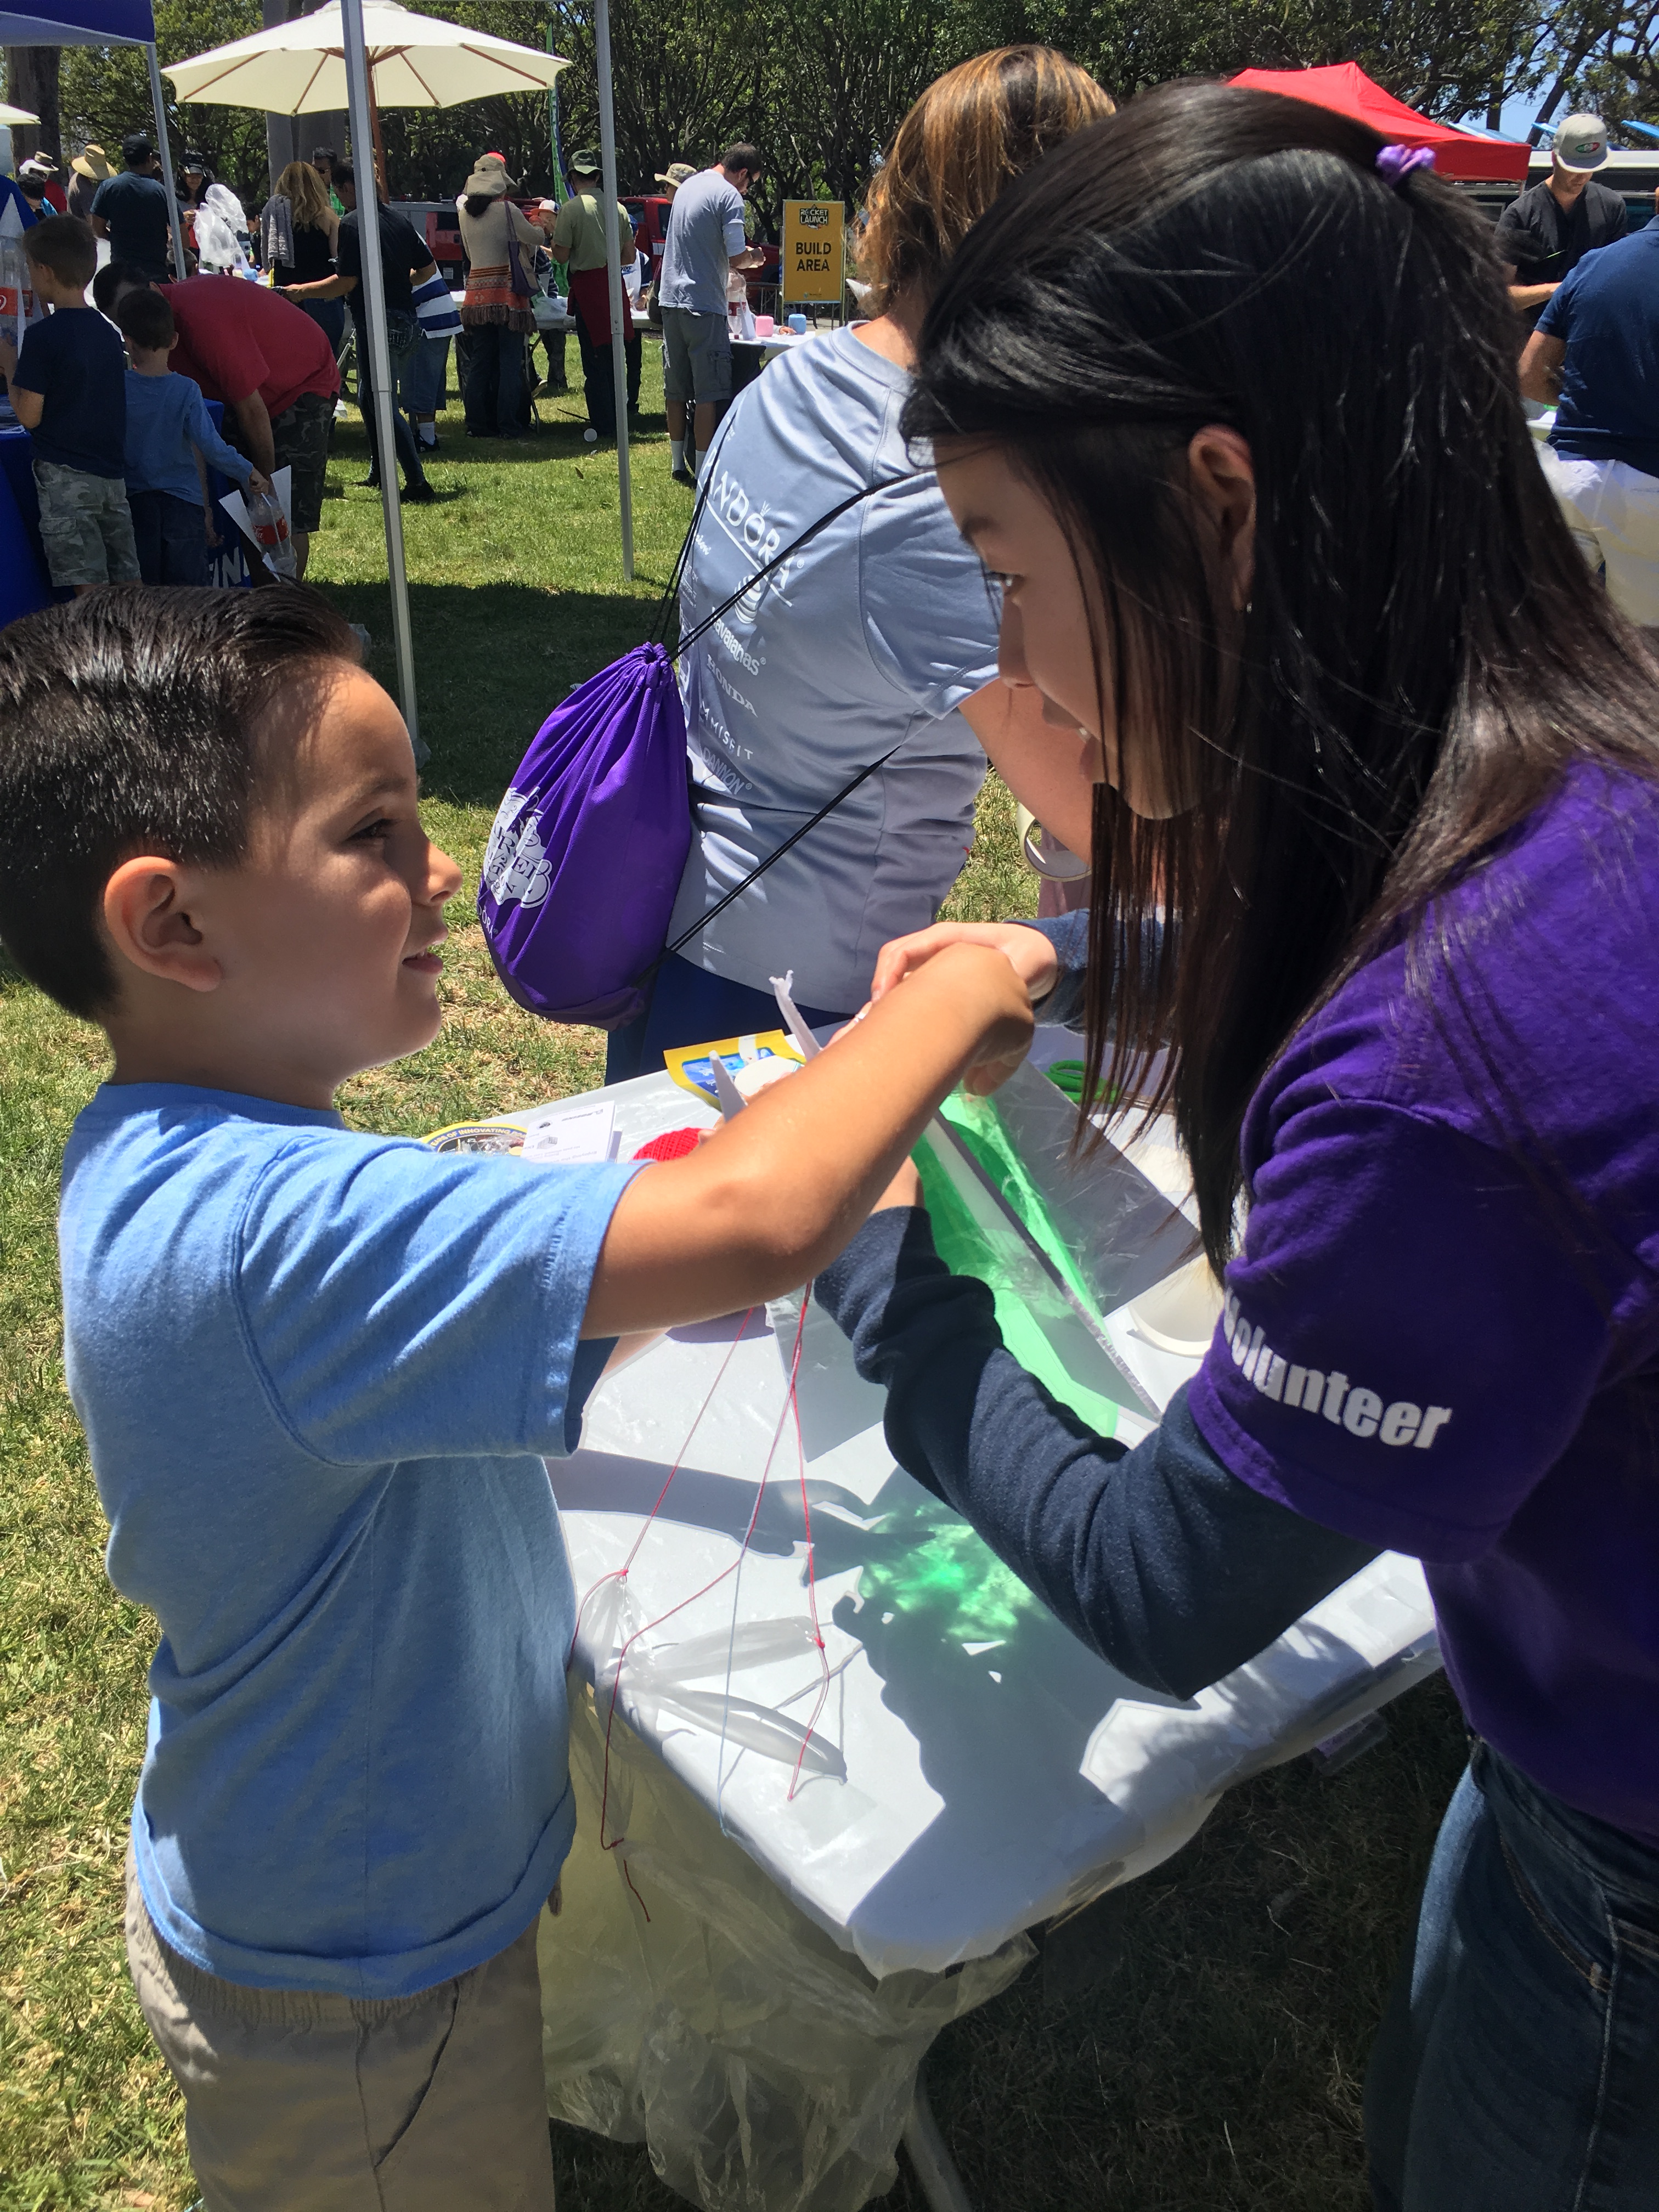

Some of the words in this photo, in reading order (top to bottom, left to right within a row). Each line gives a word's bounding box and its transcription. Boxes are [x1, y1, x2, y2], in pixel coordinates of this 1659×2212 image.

[800, 216, 828, 224] LAUNCH
[795, 242, 831, 255] BUILD
[797, 259, 830, 272] AREA
[706, 653, 758, 718] HONDA
[710, 717, 754, 760] MISFIT
[702, 746, 745, 795] DANNON
[431, 1135, 449, 1146] EARS
[1223, 1286, 1453, 1449] Volunteer
